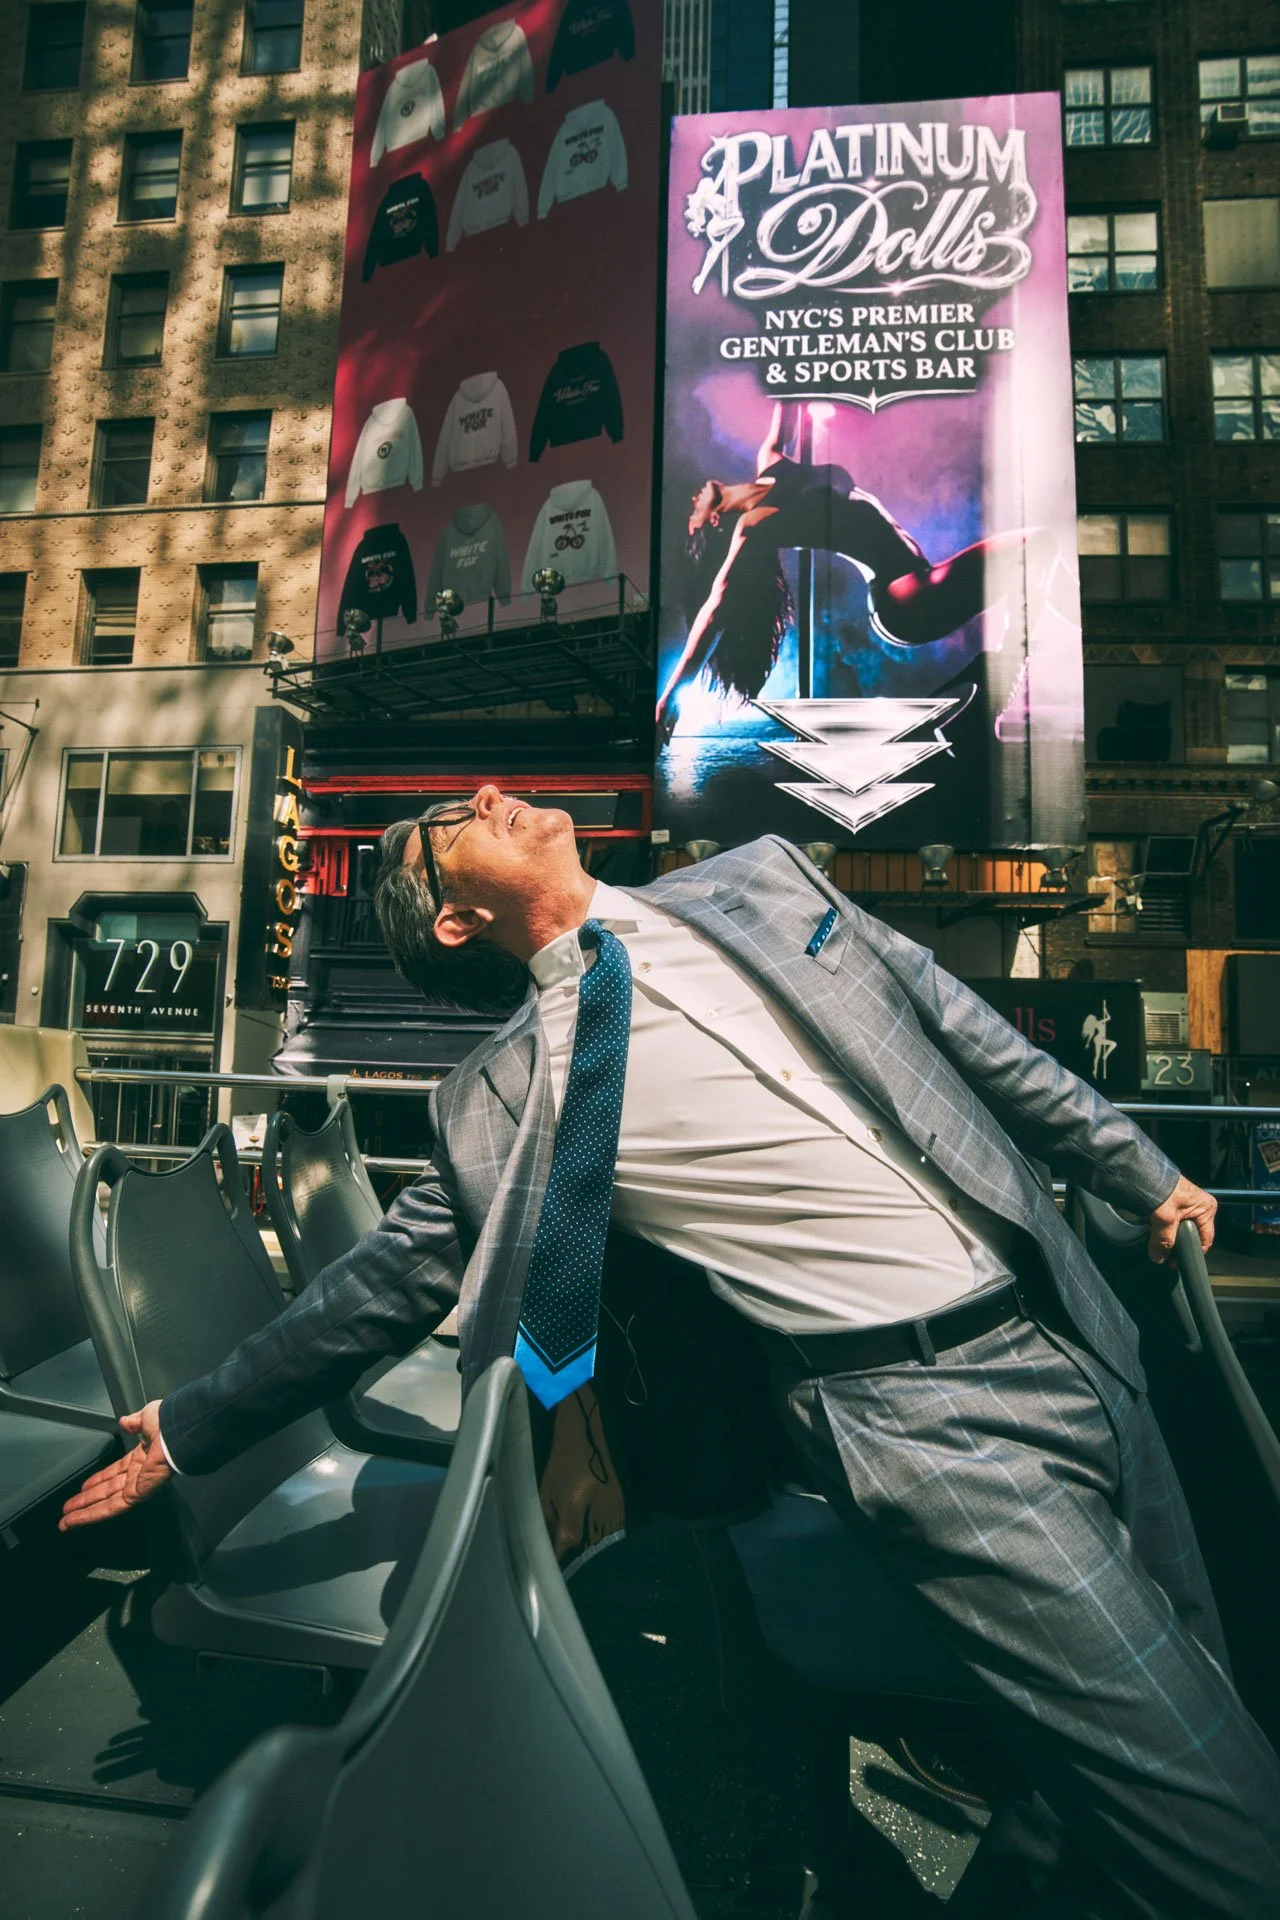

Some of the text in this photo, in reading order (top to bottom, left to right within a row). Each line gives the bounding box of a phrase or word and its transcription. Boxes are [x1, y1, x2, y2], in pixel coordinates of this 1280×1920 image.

[702, 121, 1030, 215] PLATINUM
[732, 180, 1034, 299] Dolls
[765, 303, 975, 331] NYC'S PREMIER
[720, 328, 1016, 361] GENTLEMAN'S CLUB
[765, 356, 976, 384] & SPORTS BAR
[459, 407, 494, 426] WHITE
[464, 417, 488, 434] FOX
[449, 540, 488, 559] WHITE
[455, 554, 479, 570] FOX
[275, 745, 302, 958] LAGOS
[103, 938, 194, 993] 729
[86, 1004, 200, 1017] SEVENTH AVENUE
[1012, 1007, 1057, 1043] lls
[364, 1070, 404, 1080] LAGOS
[1154, 1055, 1195, 1085] 23
